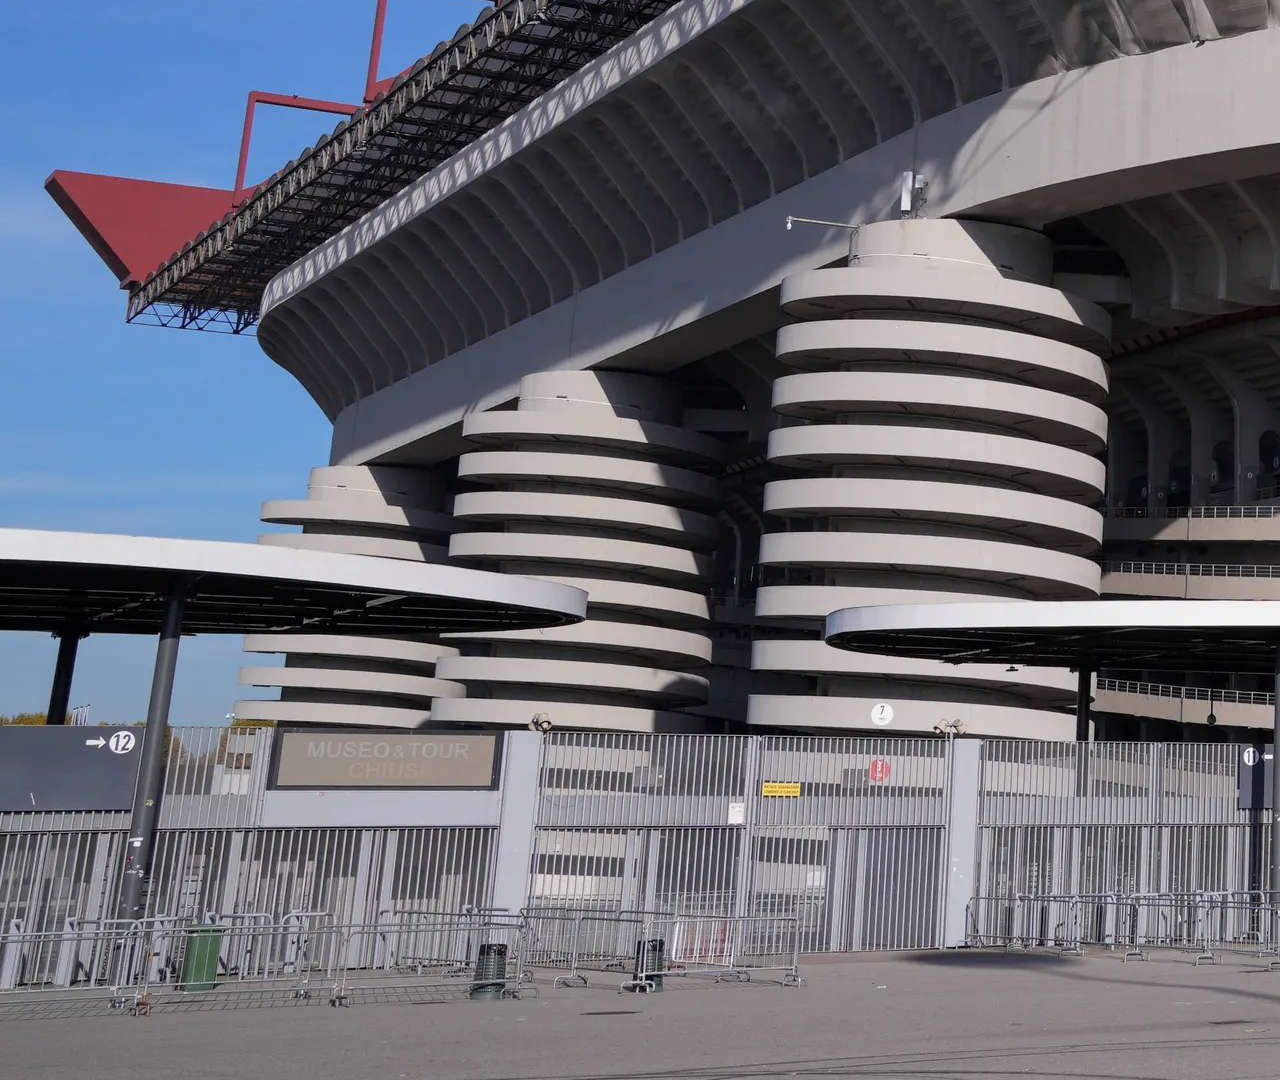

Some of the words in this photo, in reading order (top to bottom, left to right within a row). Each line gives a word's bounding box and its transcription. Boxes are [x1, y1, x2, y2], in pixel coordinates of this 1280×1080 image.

[113, 733, 132, 752] 12
[307, 741, 390, 759] MUSEO
[392, 744, 405, 759] &
[406, 741, 470, 759] TOUR
[349, 762, 424, 780] CHIUSI
